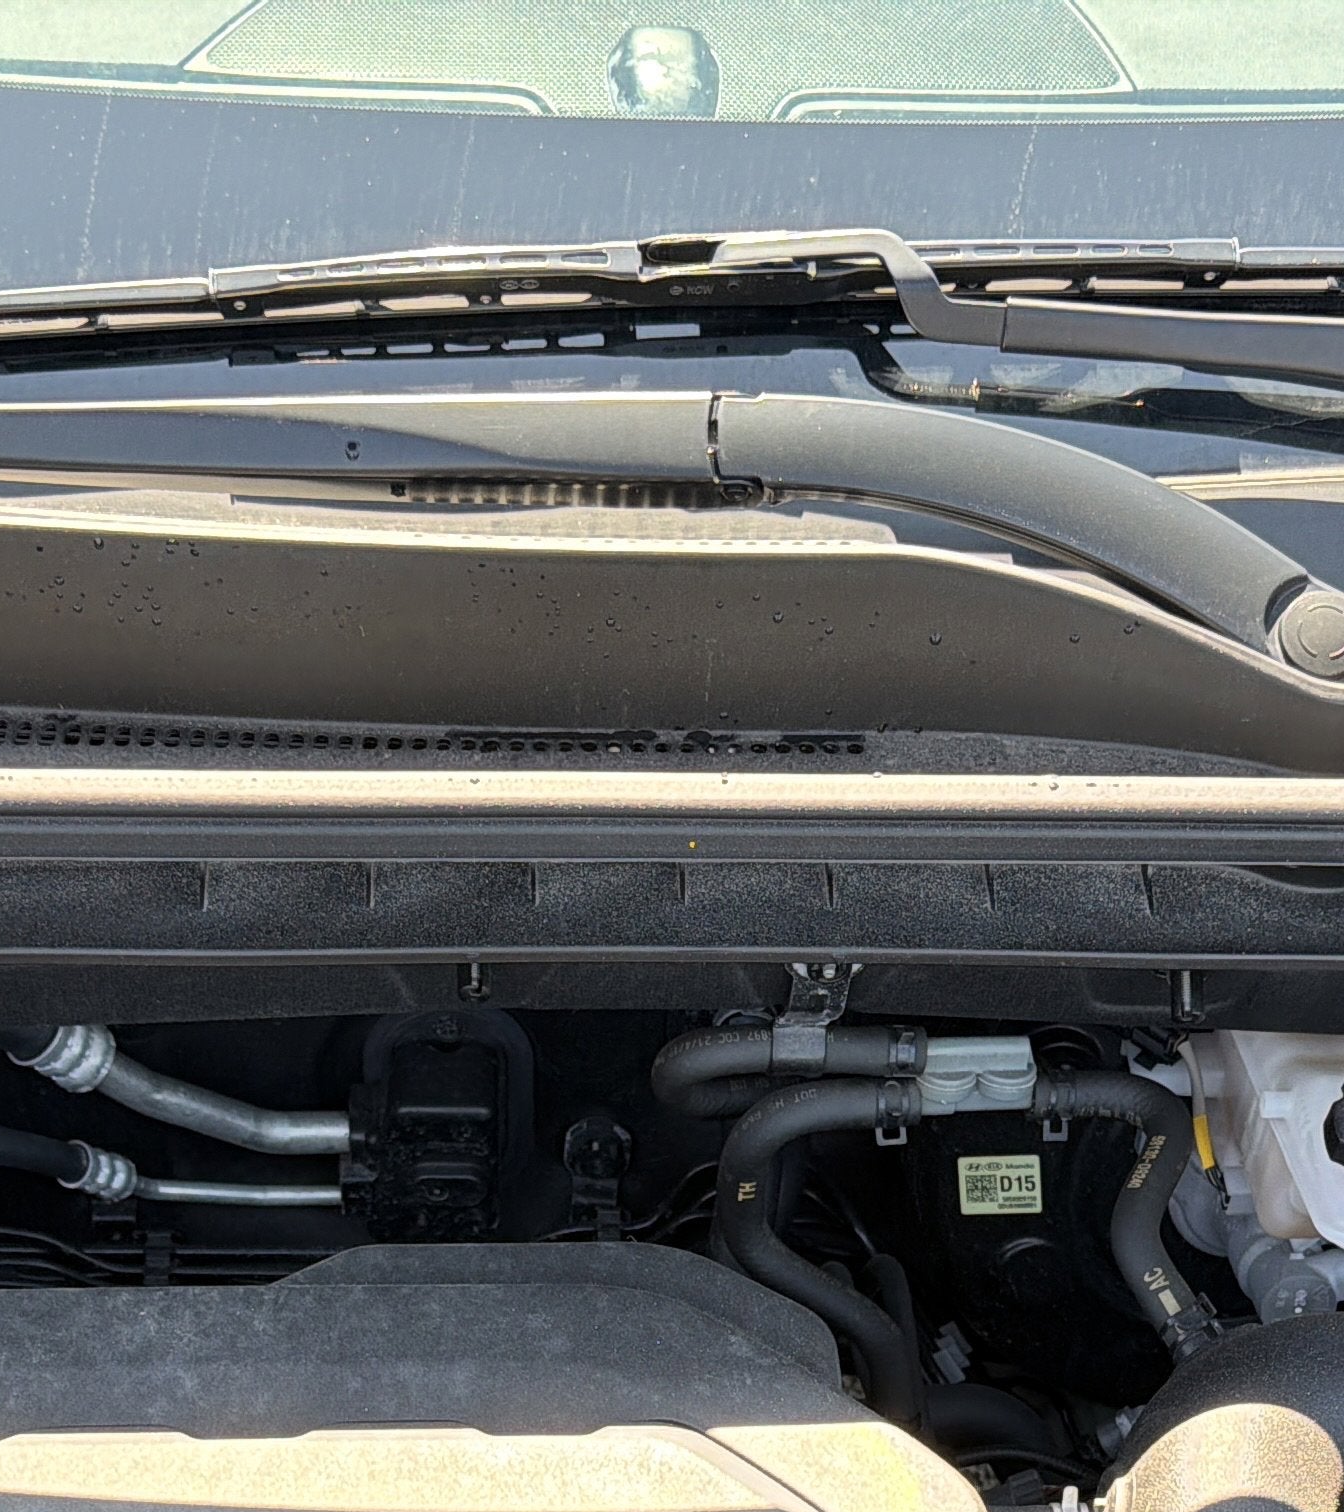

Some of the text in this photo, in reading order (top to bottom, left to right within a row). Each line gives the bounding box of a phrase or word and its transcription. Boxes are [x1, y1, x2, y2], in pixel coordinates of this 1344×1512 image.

[737, 1181, 757, 1202] TH
[1000, 1175, 1036, 1193] D15
[1143, 1267, 1170, 1291] AC
